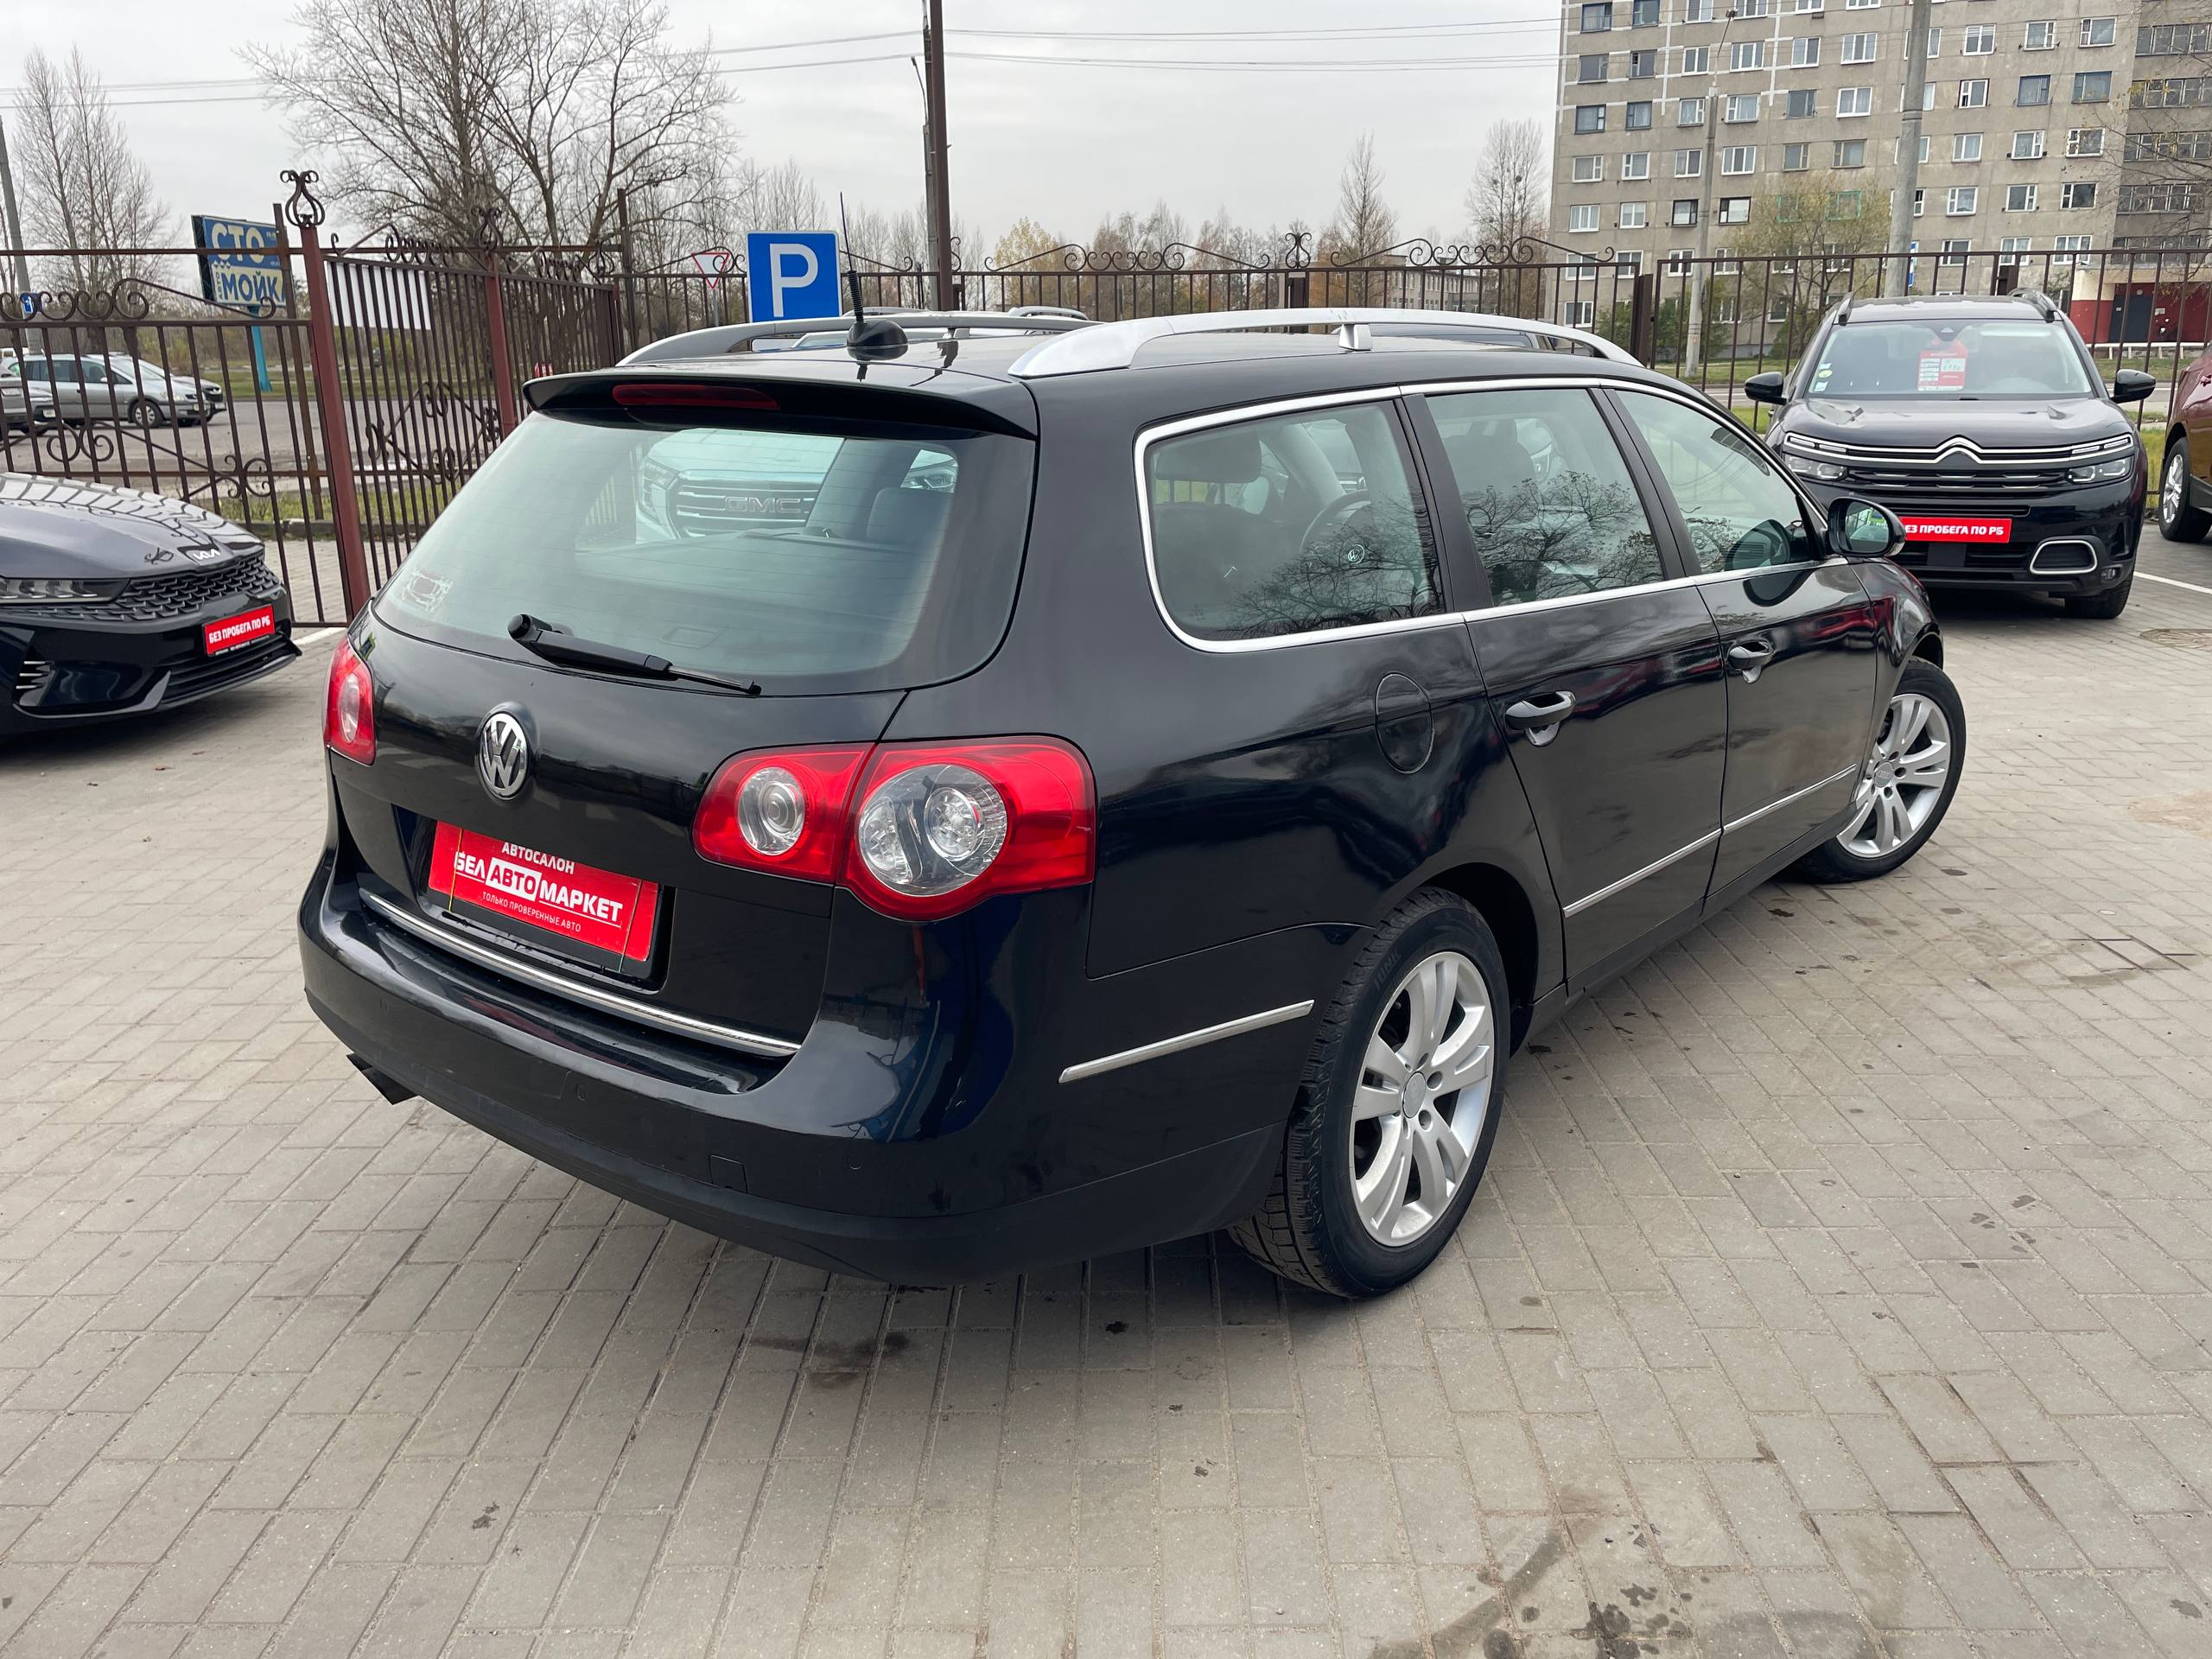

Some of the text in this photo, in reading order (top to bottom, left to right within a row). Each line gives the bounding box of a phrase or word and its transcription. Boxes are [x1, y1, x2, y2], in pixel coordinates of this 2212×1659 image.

[212, 222, 264, 263] СТО
[769, 243, 818, 318] P
[723, 496, 803, 513] GMC
[1904, 524, 2004, 536] ЕЗ ПРОБЕГА ПО РБ
[208, 631, 222, 644] БЕЗ
[222, 623, 251, 639] ПРОБЕГА
[251, 618, 262, 631] ПО
[261, 615, 271, 627] РБ
[501, 842, 575, 874] АВТОСАЛОН
[482, 891, 582, 932] ТОЛЬКО ПРОВЕРЕННЫЕ АВТО
